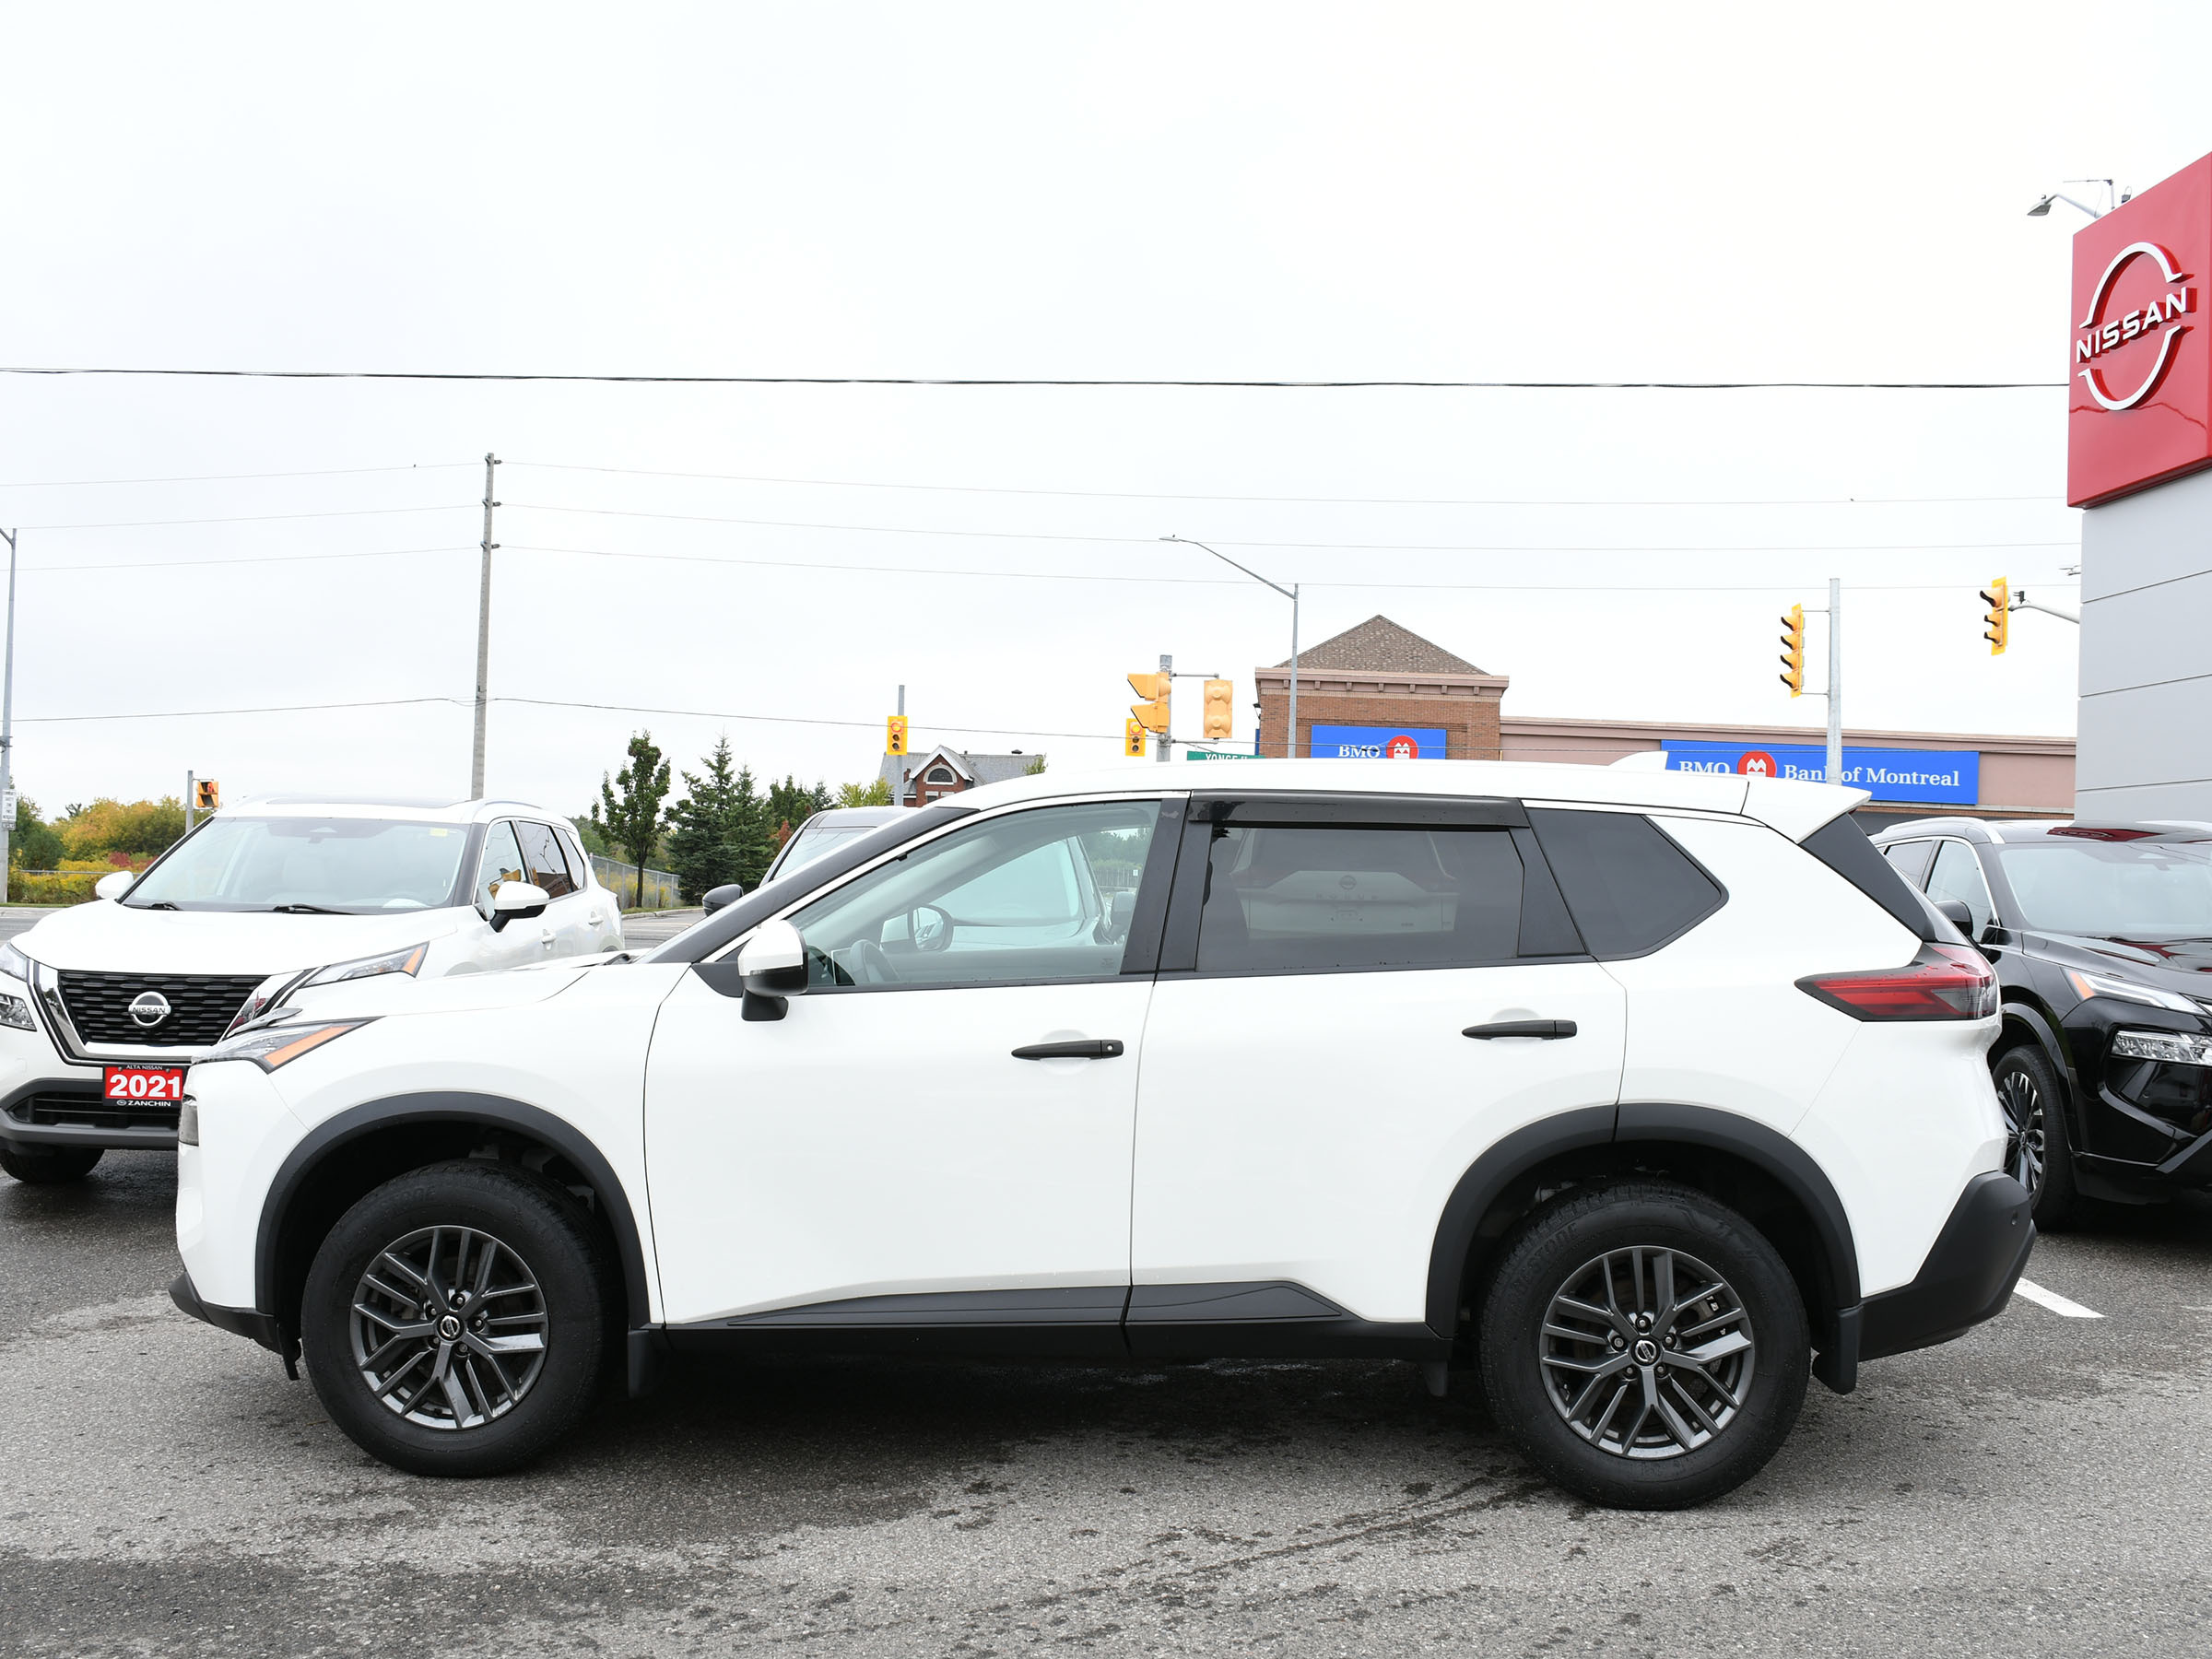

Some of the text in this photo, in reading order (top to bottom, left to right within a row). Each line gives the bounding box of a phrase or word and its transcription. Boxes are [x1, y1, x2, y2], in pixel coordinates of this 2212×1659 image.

[2076, 287, 2190, 363] NISSAN
[1337, 744, 1381, 759] BMO
[1678, 760, 1961, 786] BMO Ban of Montreal
[110, 1074, 181, 1099] 2021
